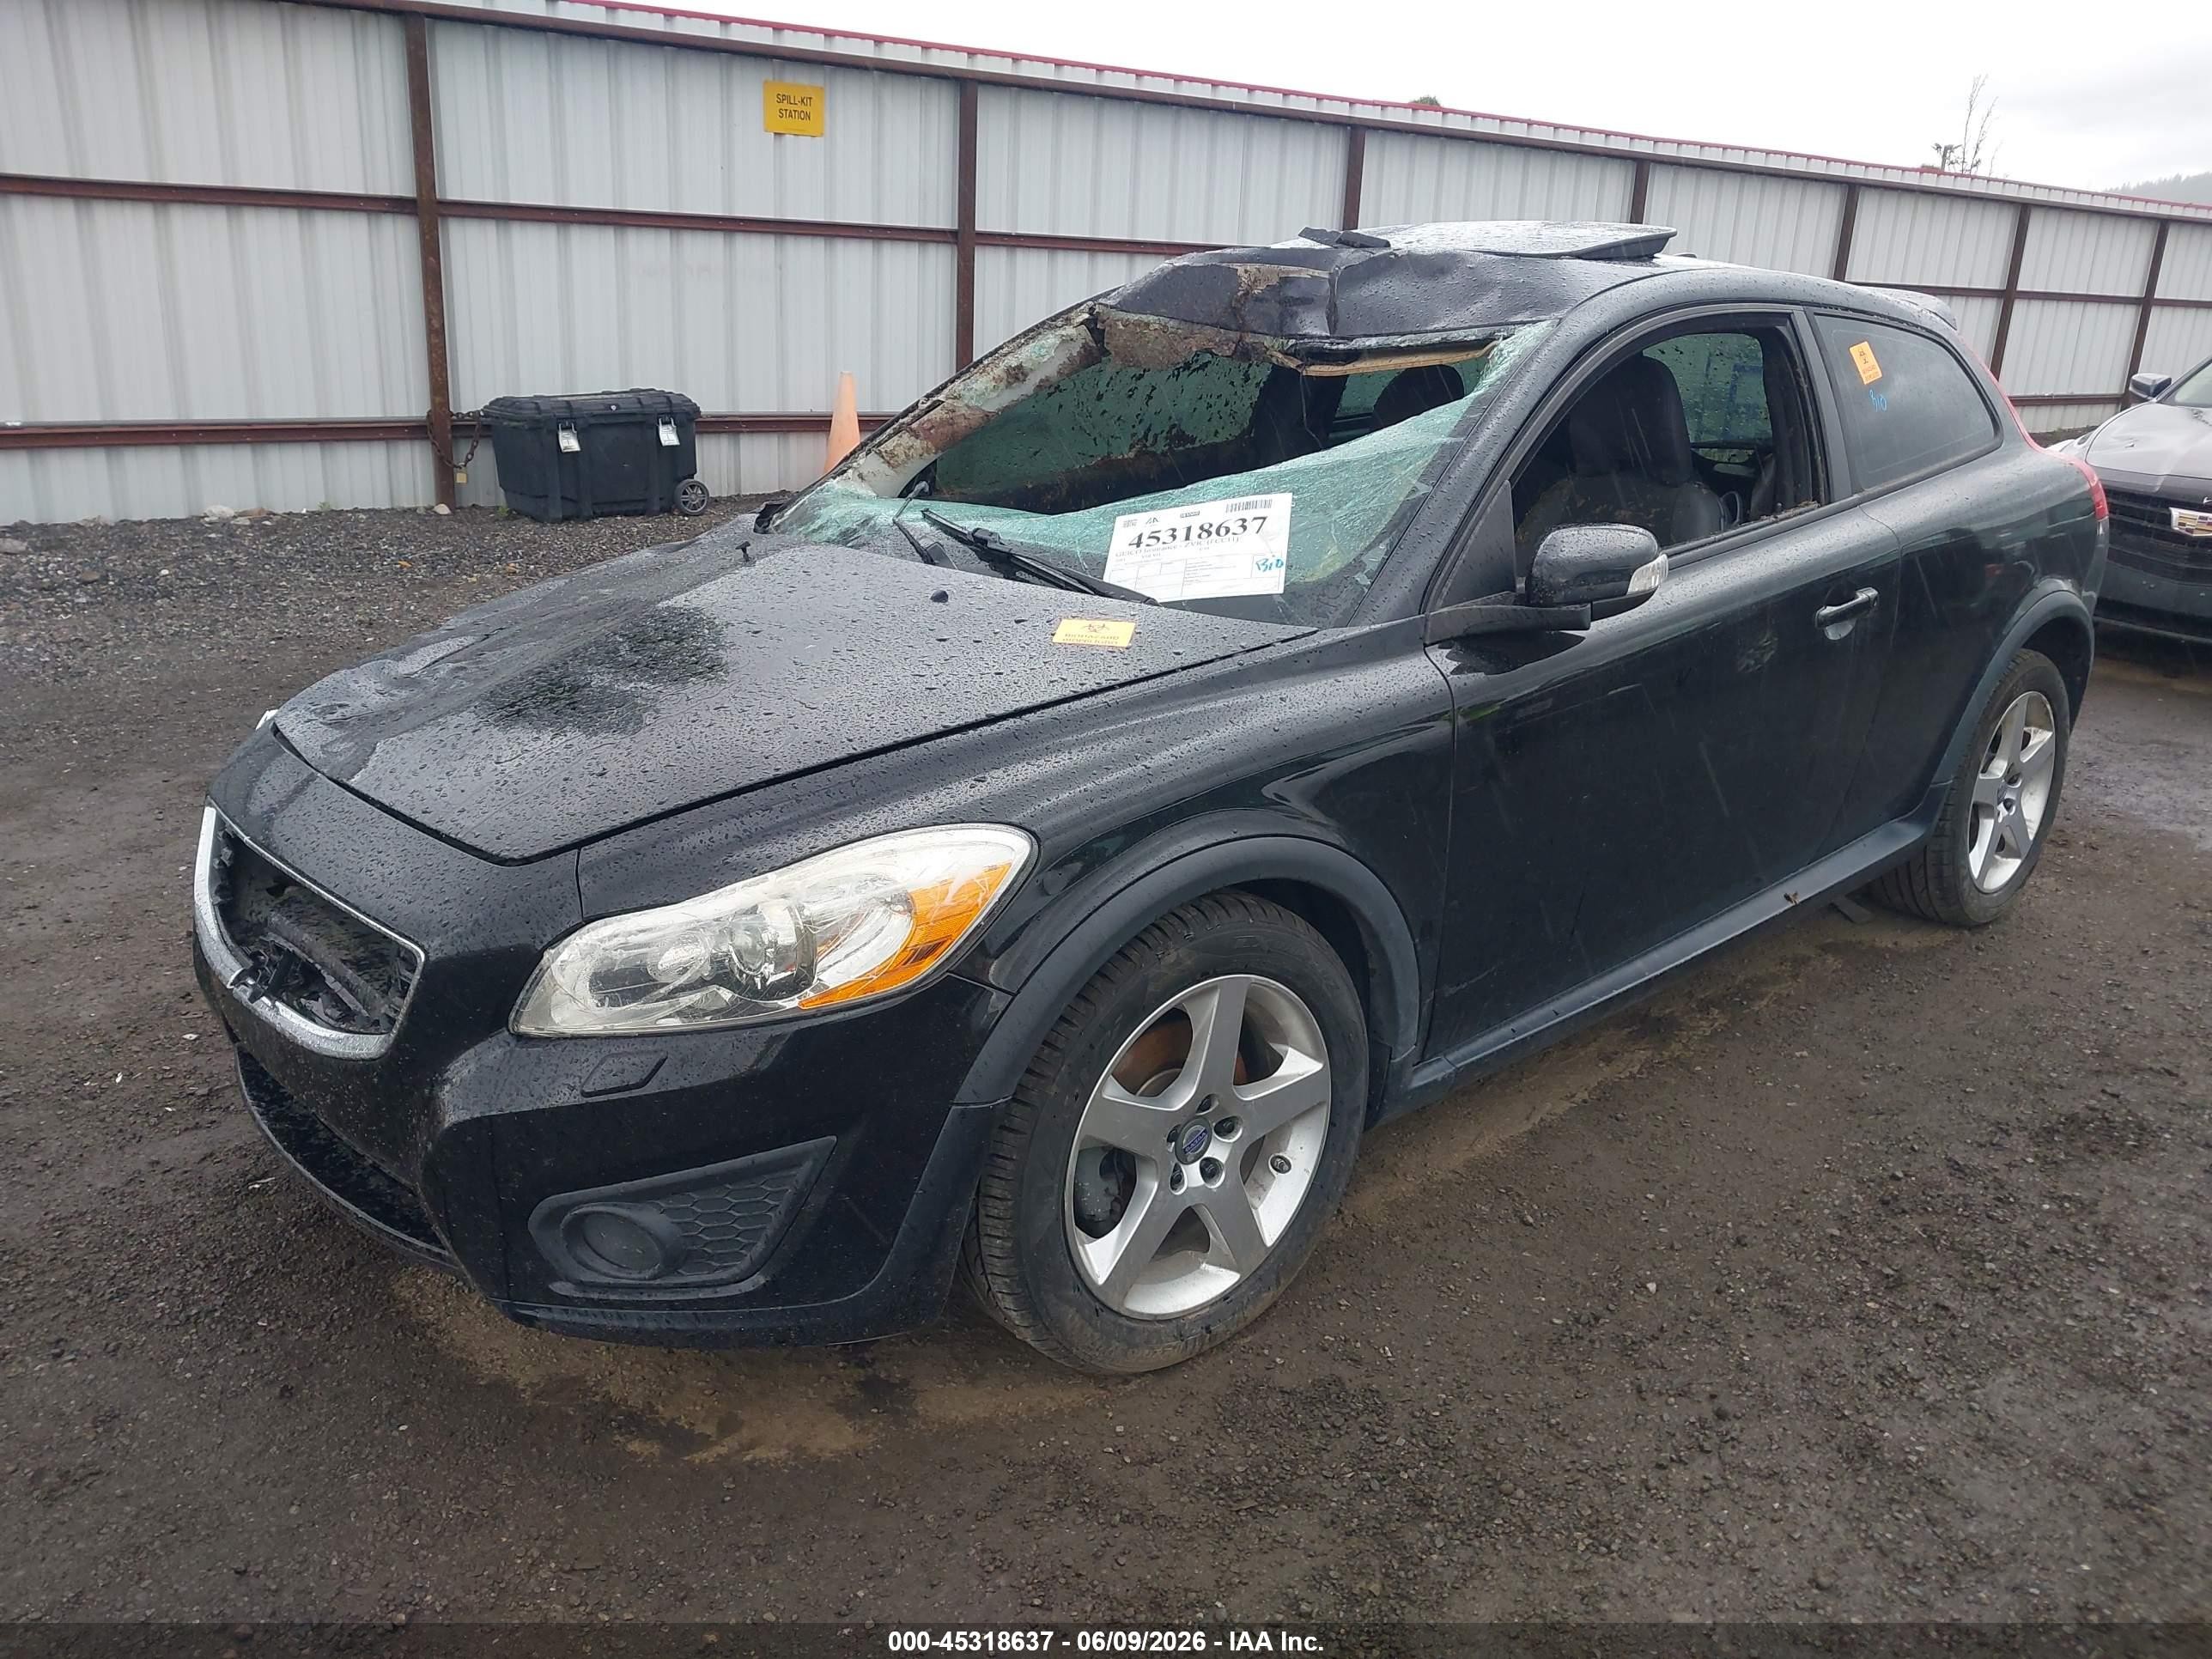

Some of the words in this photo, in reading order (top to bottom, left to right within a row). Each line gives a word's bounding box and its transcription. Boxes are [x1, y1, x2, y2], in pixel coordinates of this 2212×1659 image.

[775, 93, 813, 107] SPILL-KIT
[778, 108, 811, 121] STATION
[1128, 516, 1268, 548] 45318637
